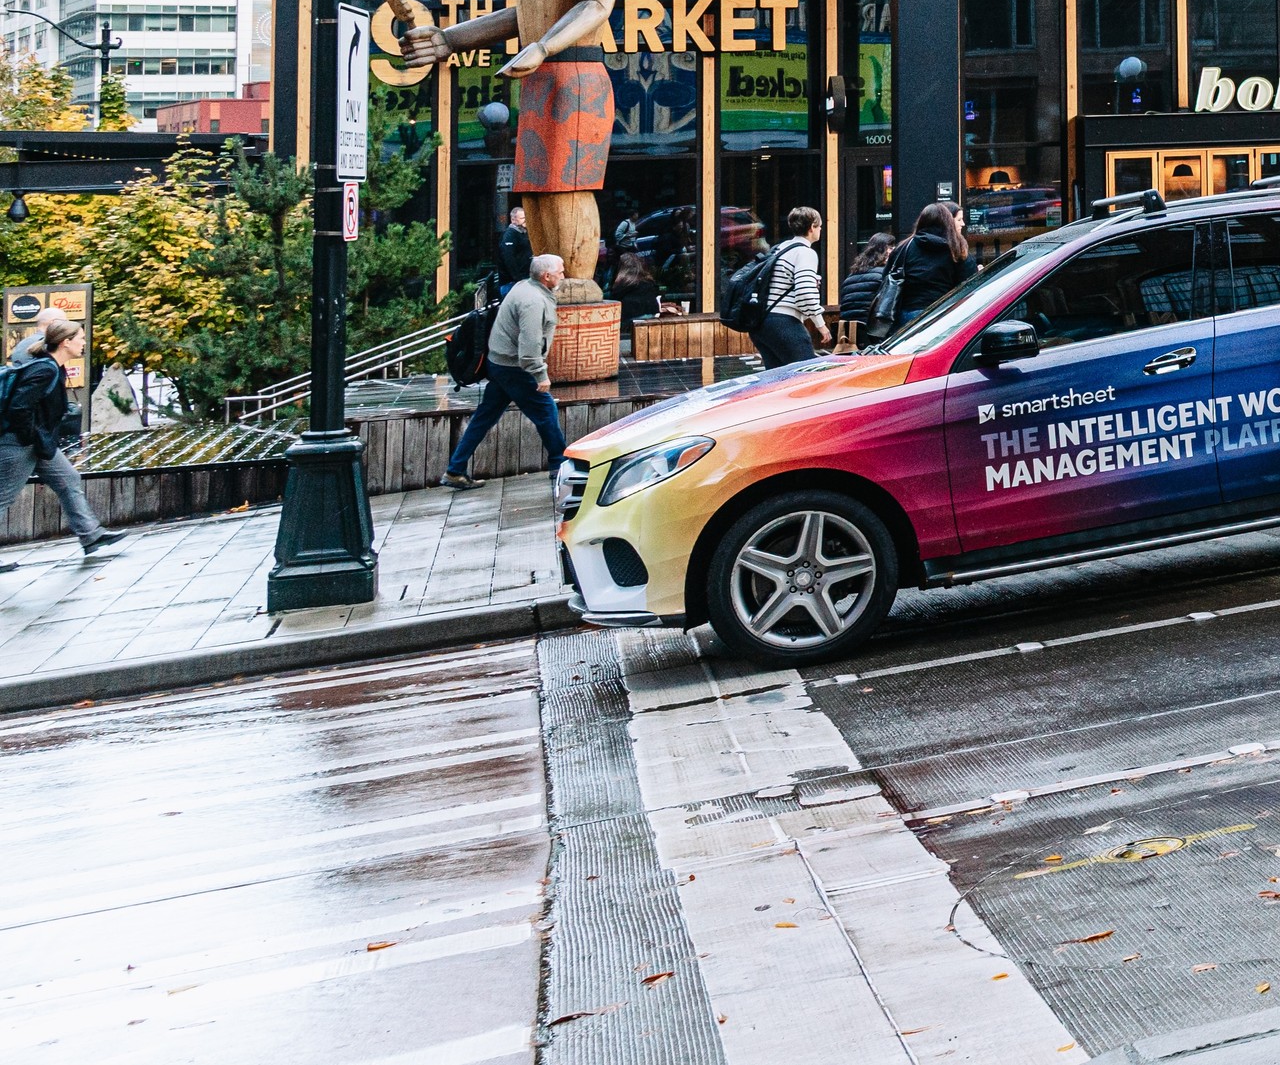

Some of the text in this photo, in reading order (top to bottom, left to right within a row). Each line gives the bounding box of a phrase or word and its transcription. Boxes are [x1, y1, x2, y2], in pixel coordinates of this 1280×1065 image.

[446, 49, 491, 68] AVE
[345, 99, 362, 123] ONLY
[865, 135, 885, 144] 1600
[1001, 385, 1116, 418] smartsheet
[980, 426, 1041, 460] THE
[1047, 395, 1233, 450] INTELLIGENT
[984, 432, 1197, 492] MANAGEMENT
